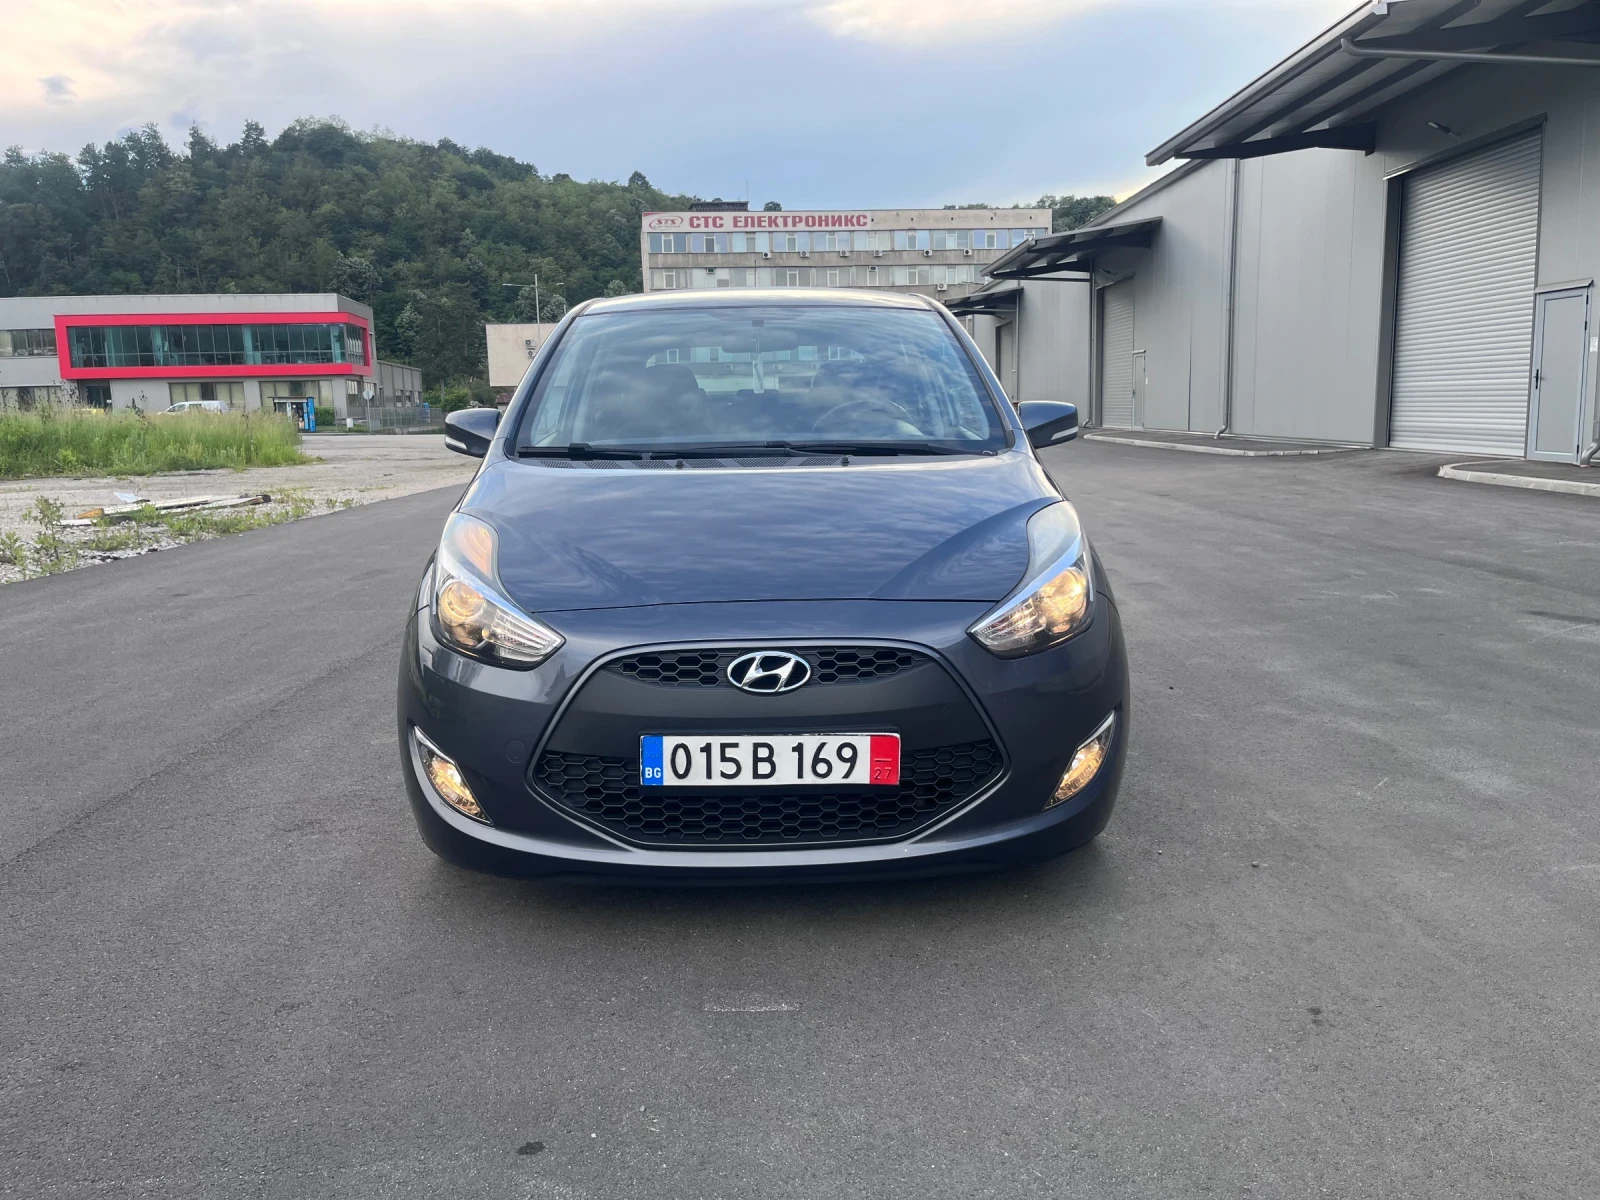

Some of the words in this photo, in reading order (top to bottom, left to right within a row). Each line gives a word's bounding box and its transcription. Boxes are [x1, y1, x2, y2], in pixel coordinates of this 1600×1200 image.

[689, 216, 724, 228] СТС
[733, 215, 868, 228] ЕЛЕКТРОНИКС
[645, 767, 662, 778] BG
[874, 766, 892, 780] 27
